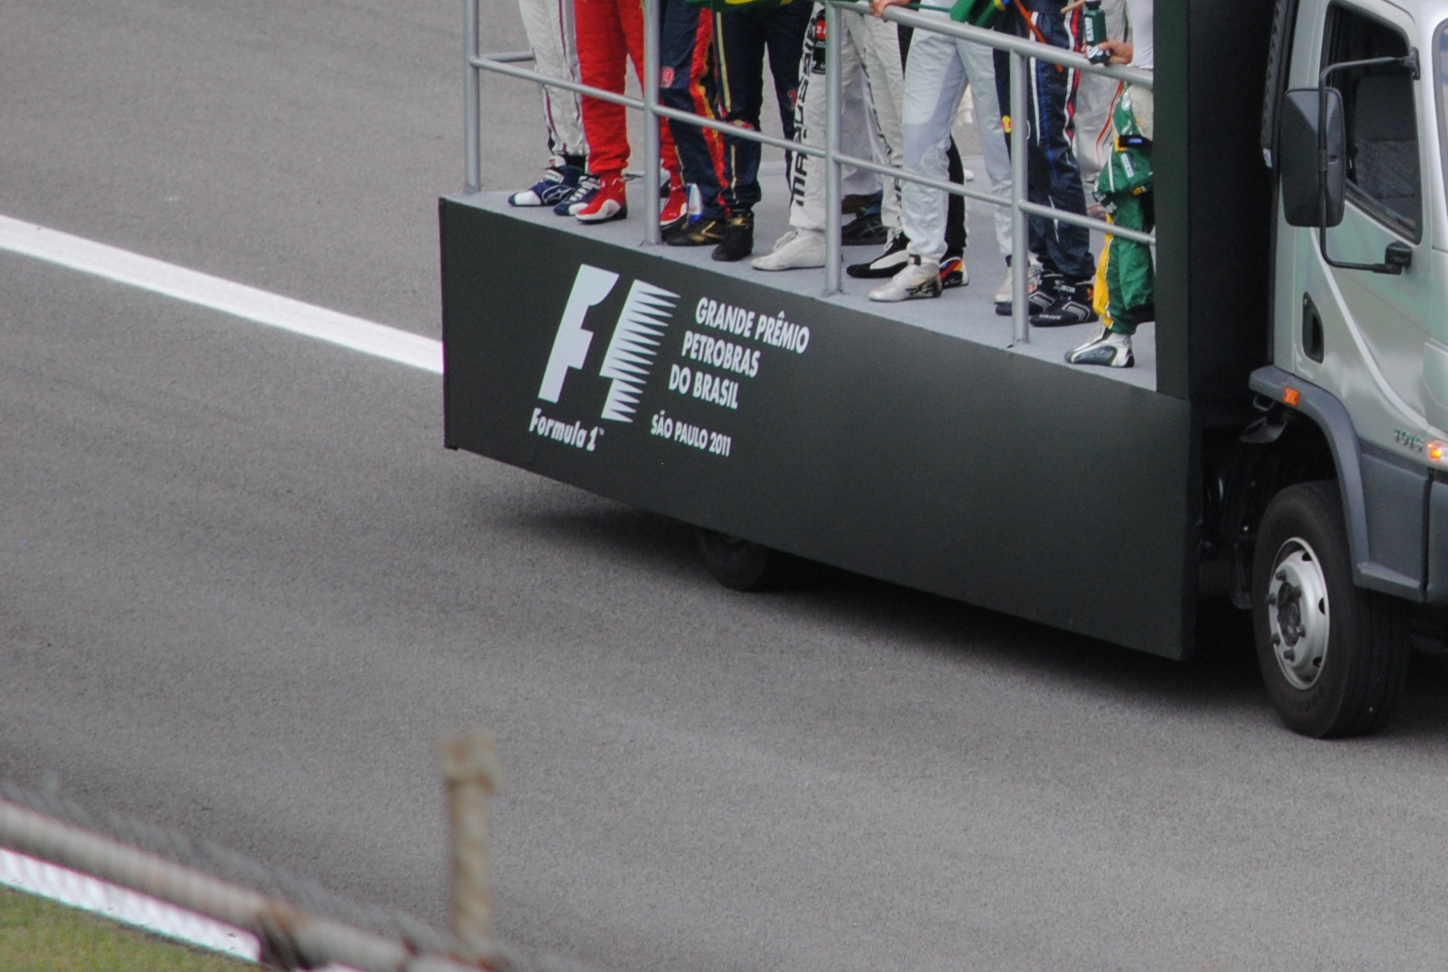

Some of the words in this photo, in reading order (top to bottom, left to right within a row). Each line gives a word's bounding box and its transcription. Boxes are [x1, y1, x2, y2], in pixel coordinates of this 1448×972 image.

[695, 296, 755, 337] GRANDE
[754, 310, 811, 354] PRÊMIO
[681, 330, 761, 378] PETROBRAS
[668, 364, 691, 395] DO
[692, 371, 738, 409] BRASIL
[528, 408, 587, 449] Formula
[650, 410, 673, 439] SÃO
[674, 421, 708, 450] PAULO
[708, 431, 732, 457] 2011
